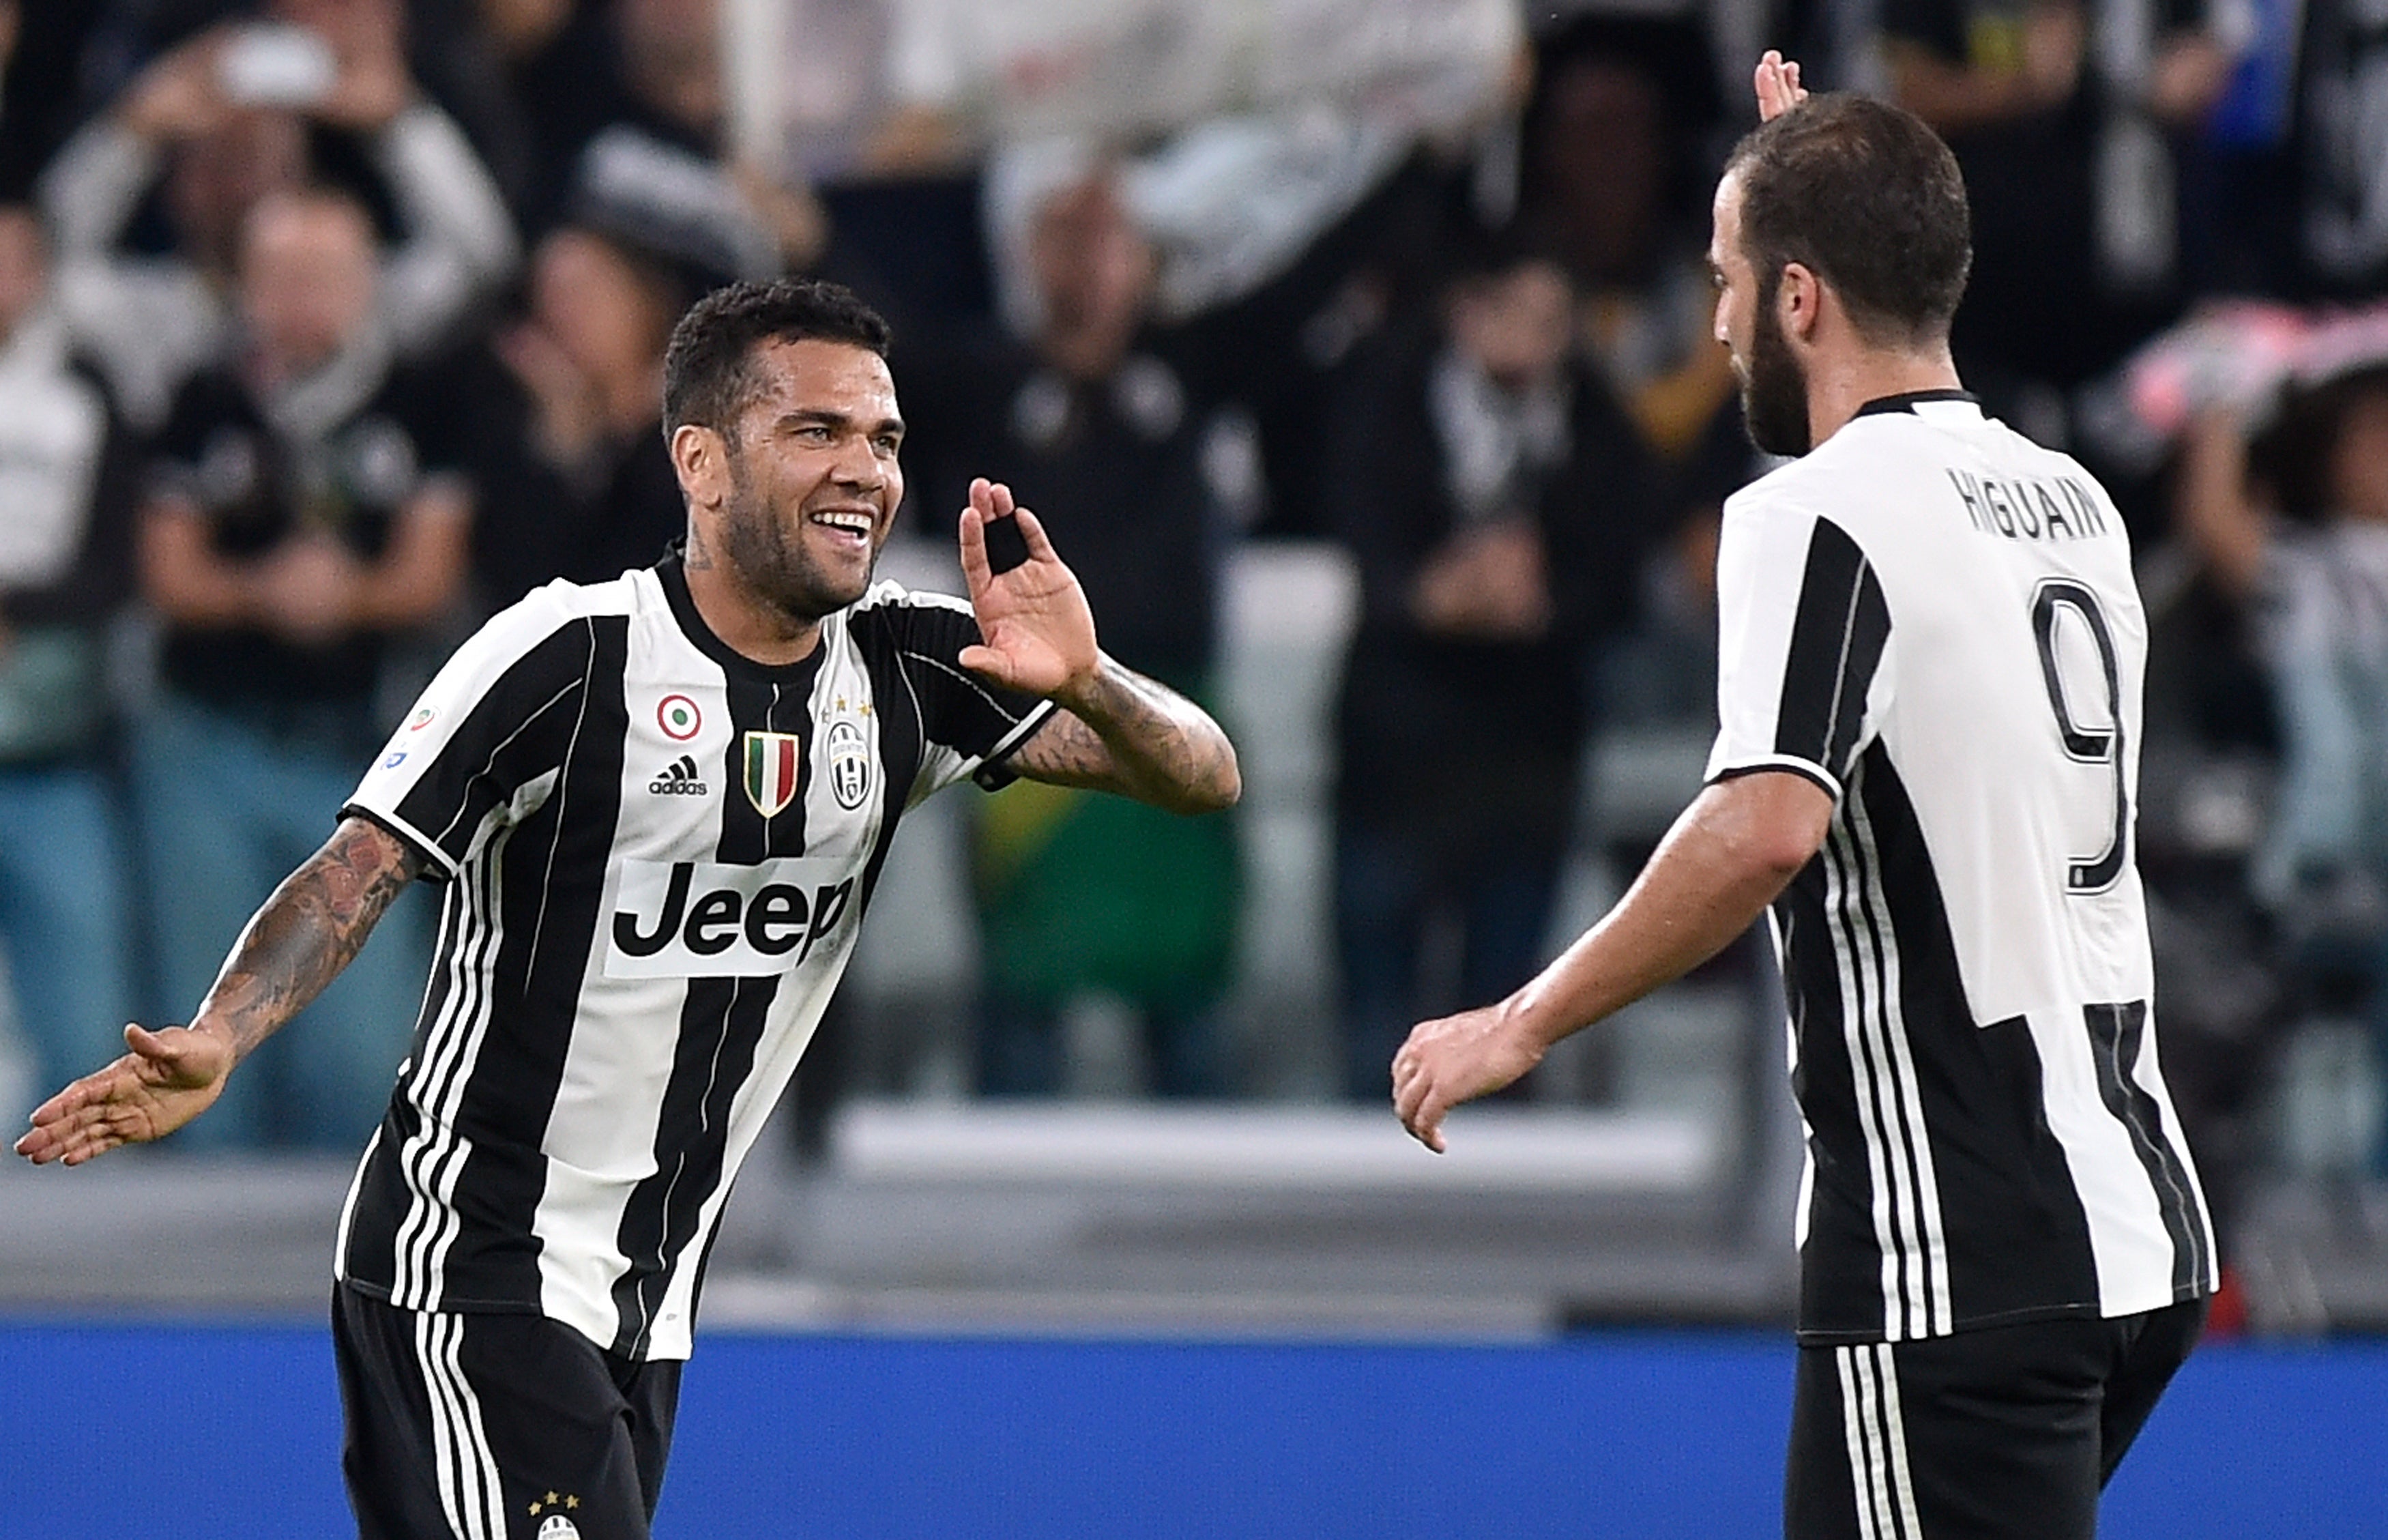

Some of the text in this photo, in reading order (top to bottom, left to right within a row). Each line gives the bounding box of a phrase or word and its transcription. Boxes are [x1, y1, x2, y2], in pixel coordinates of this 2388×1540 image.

[1946, 467, 2108, 538] HIGUAIN
[2029, 577, 2127, 895] 9
[648, 779, 708, 796] adidas
[614, 862, 854, 968] Jeep
